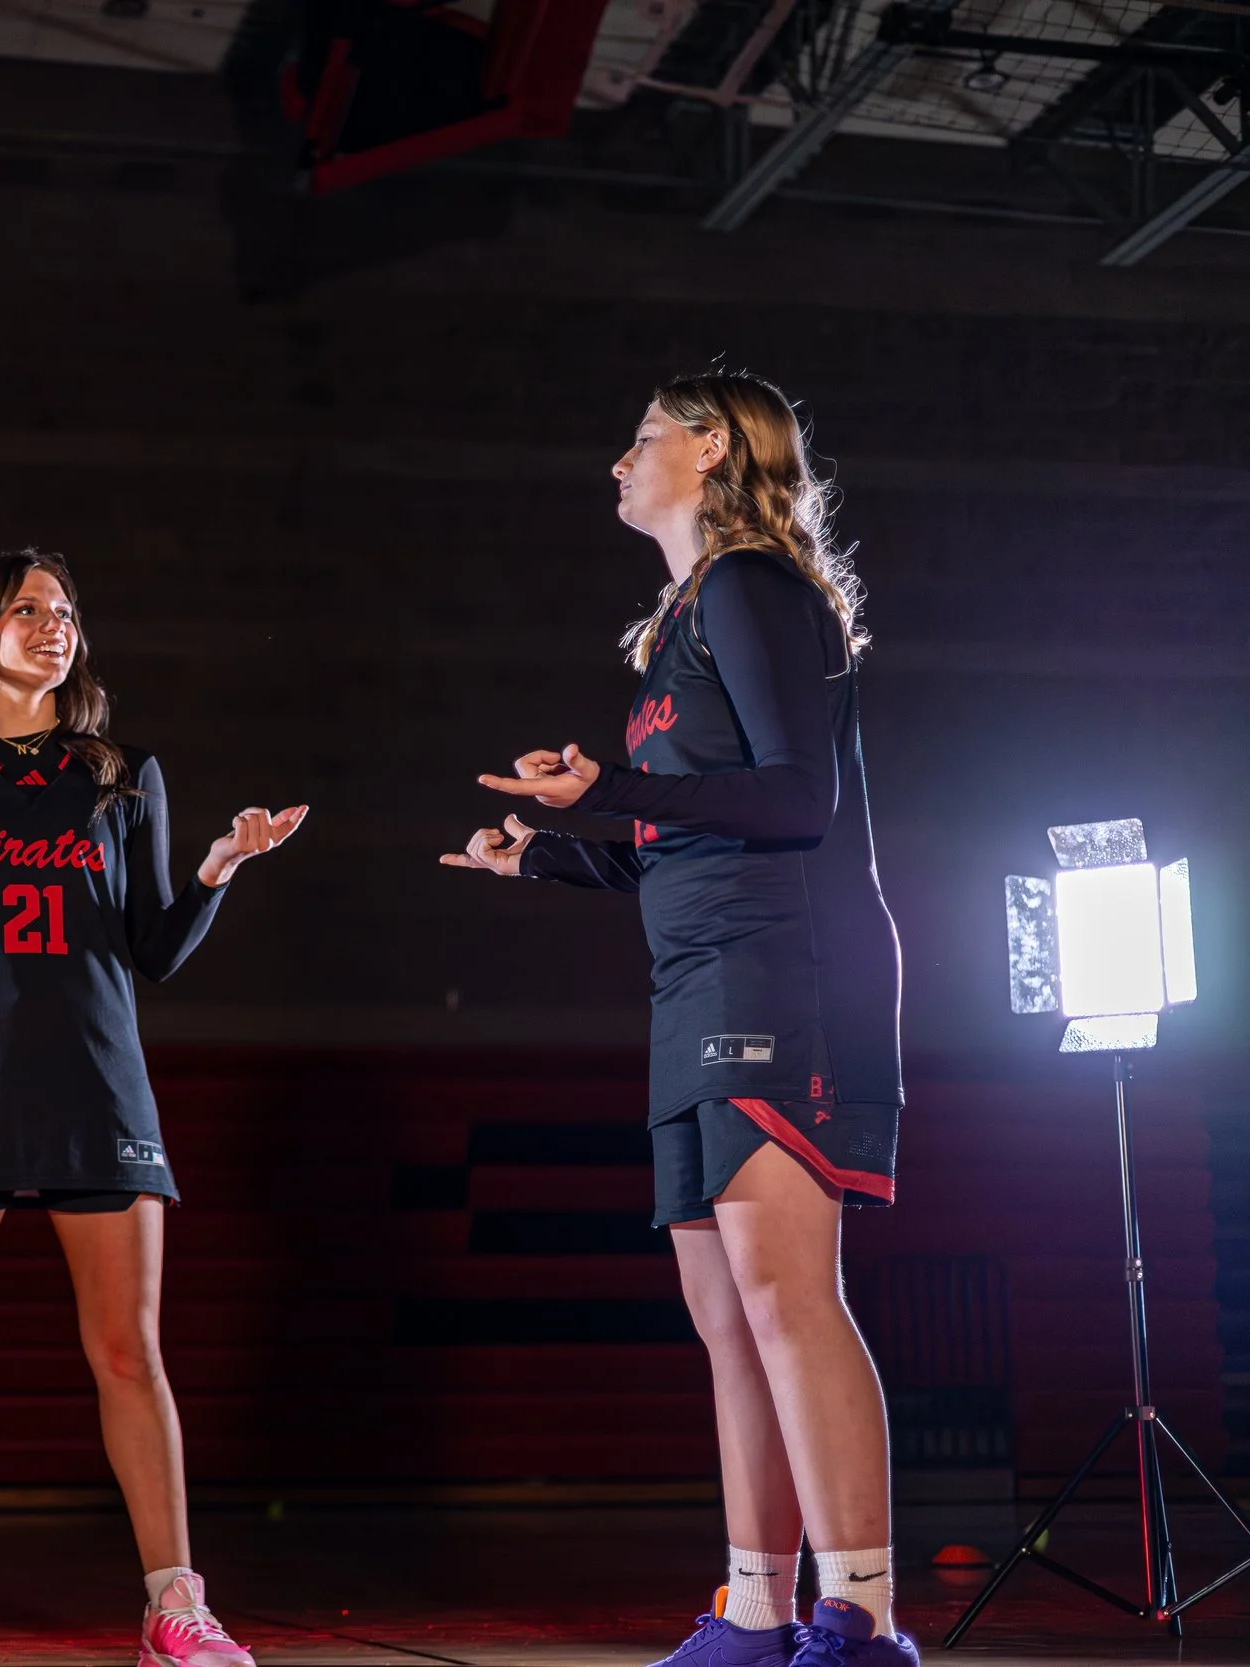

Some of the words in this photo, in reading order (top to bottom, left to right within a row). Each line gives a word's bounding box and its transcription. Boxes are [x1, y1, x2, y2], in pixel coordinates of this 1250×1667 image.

[17, 744, 27, 755] N
[2, 884, 69, 955] 21
[728, 1046, 734, 1055] L
